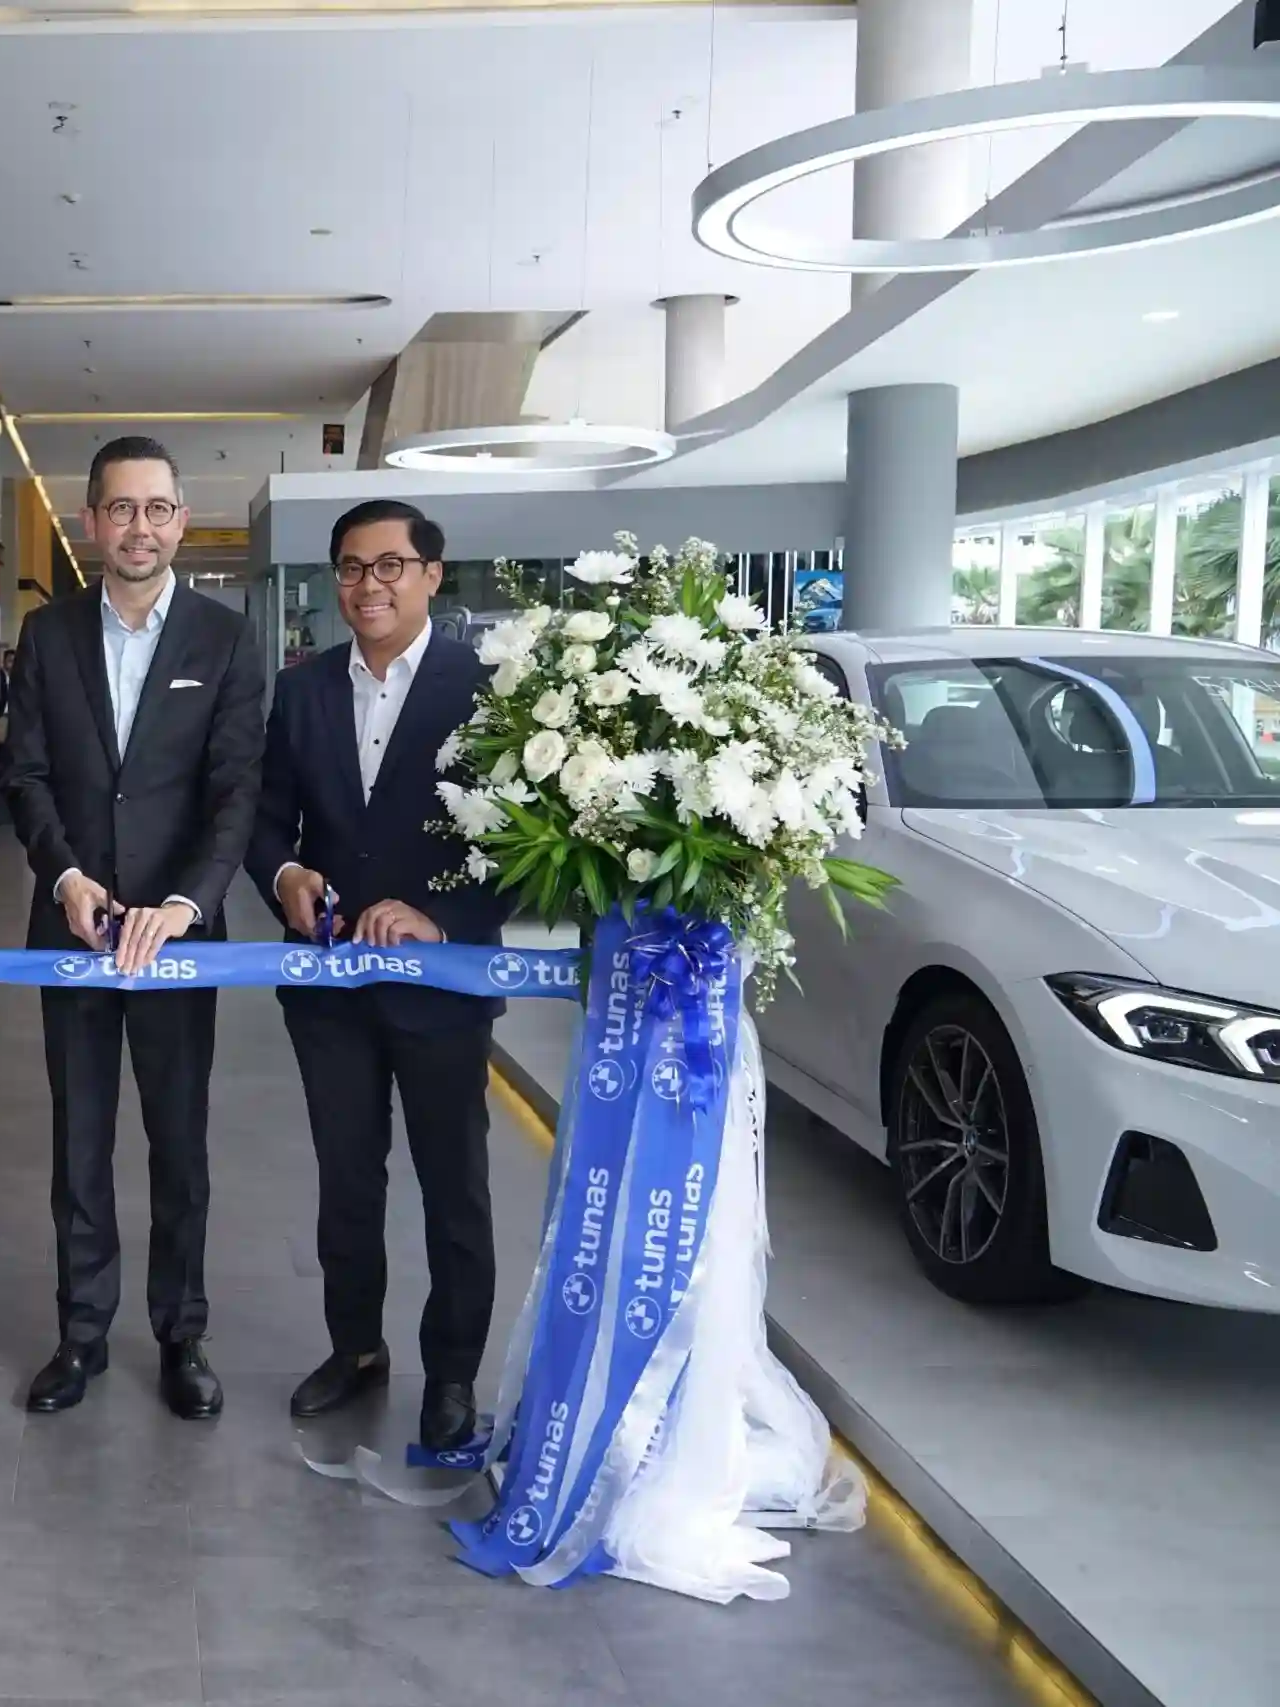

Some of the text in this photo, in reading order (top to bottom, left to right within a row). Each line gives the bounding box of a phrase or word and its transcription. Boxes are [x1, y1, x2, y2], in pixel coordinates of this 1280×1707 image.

[99, 955, 197, 979] tnas
[325, 953, 423, 978] tunas
[598, 952, 630, 1053] tunas
[573, 1167, 609, 1268] tunas
[634, 1188, 672, 1292] tunas
[526, 1401, 568, 1500] tunas
